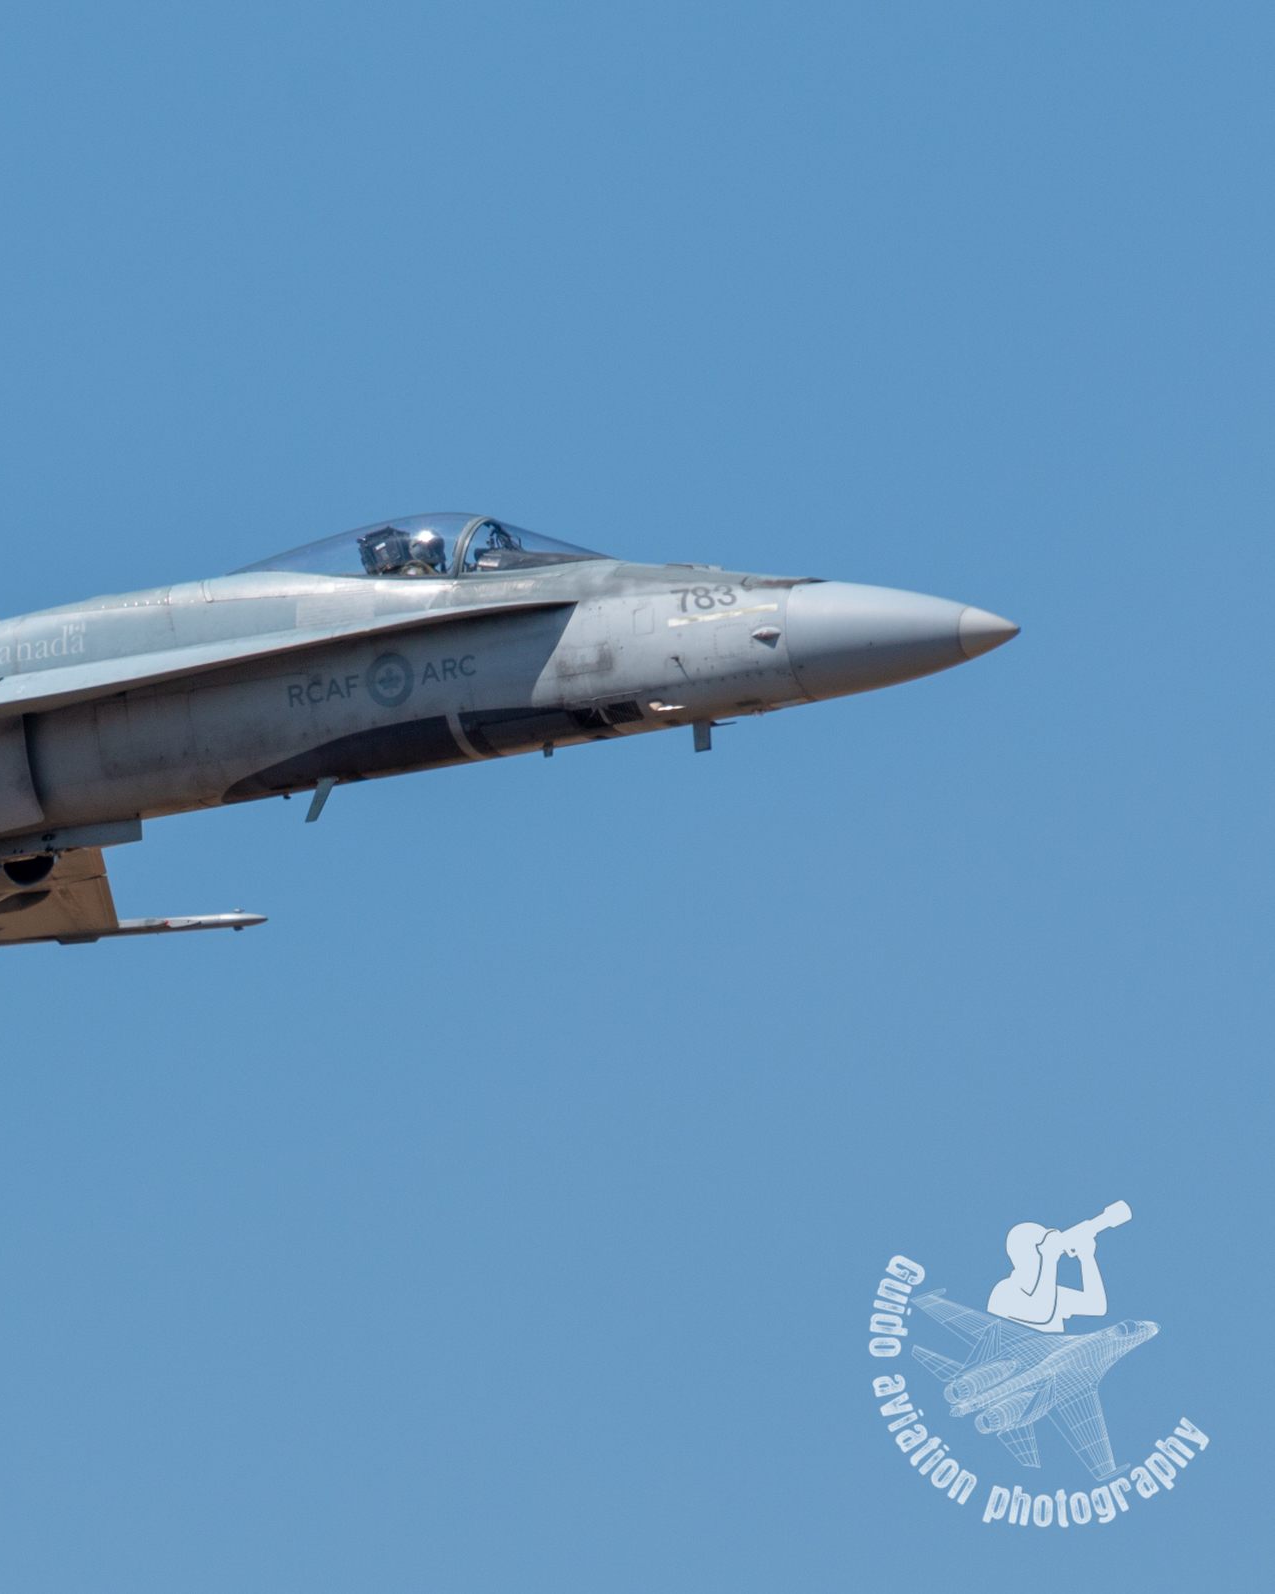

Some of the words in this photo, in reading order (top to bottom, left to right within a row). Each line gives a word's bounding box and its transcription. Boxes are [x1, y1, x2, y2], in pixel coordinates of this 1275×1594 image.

[670, 584, 737, 613] 783
[287, 674, 359, 707] RCAF
[422, 655, 476, 685] ARC
